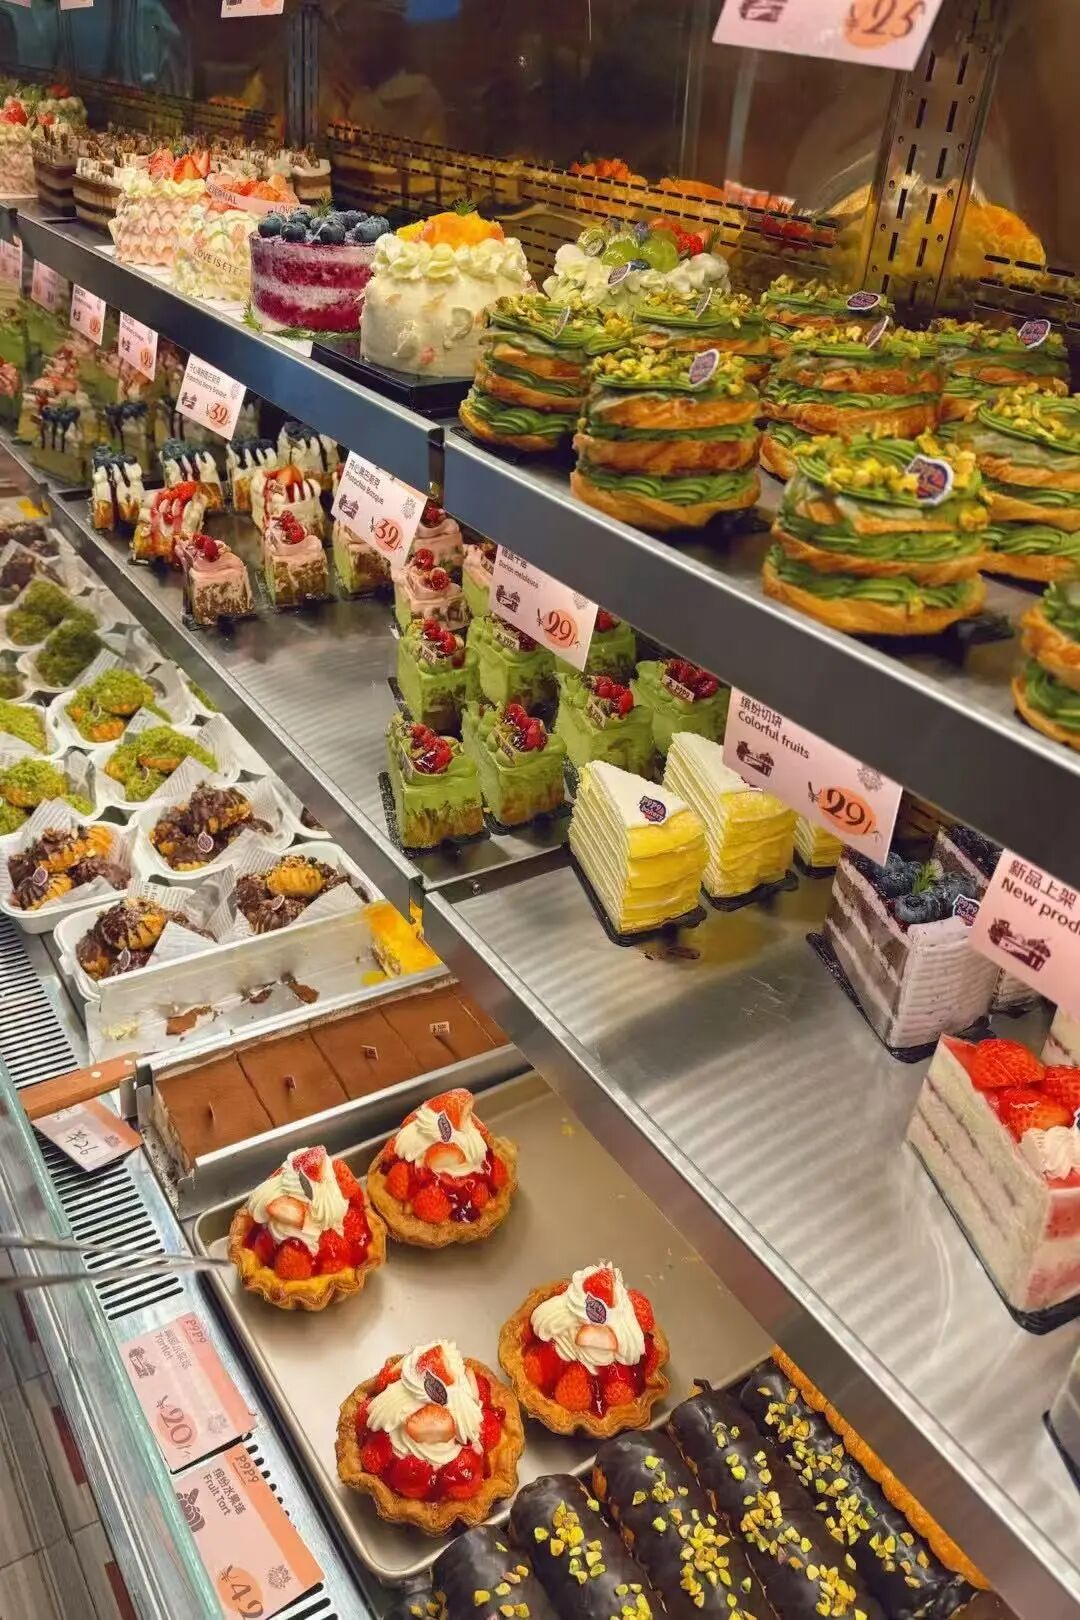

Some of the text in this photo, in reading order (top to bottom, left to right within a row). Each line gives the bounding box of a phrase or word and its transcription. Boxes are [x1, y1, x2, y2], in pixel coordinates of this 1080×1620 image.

[193, 248, 213, 264] LOVE
[737, 710, 810, 760] Colorful fruits
[740, 696, 782, 730] 缤纷切块
[1000, 877, 1080, 936] New prod
[1008, 860, 1077, 911] 新品上架
[235, 1454, 260, 1484] P9P9
[203, 1474, 231, 1517] Fruit Tart
[212, 1468, 247, 1516] 缤纷水果塔
